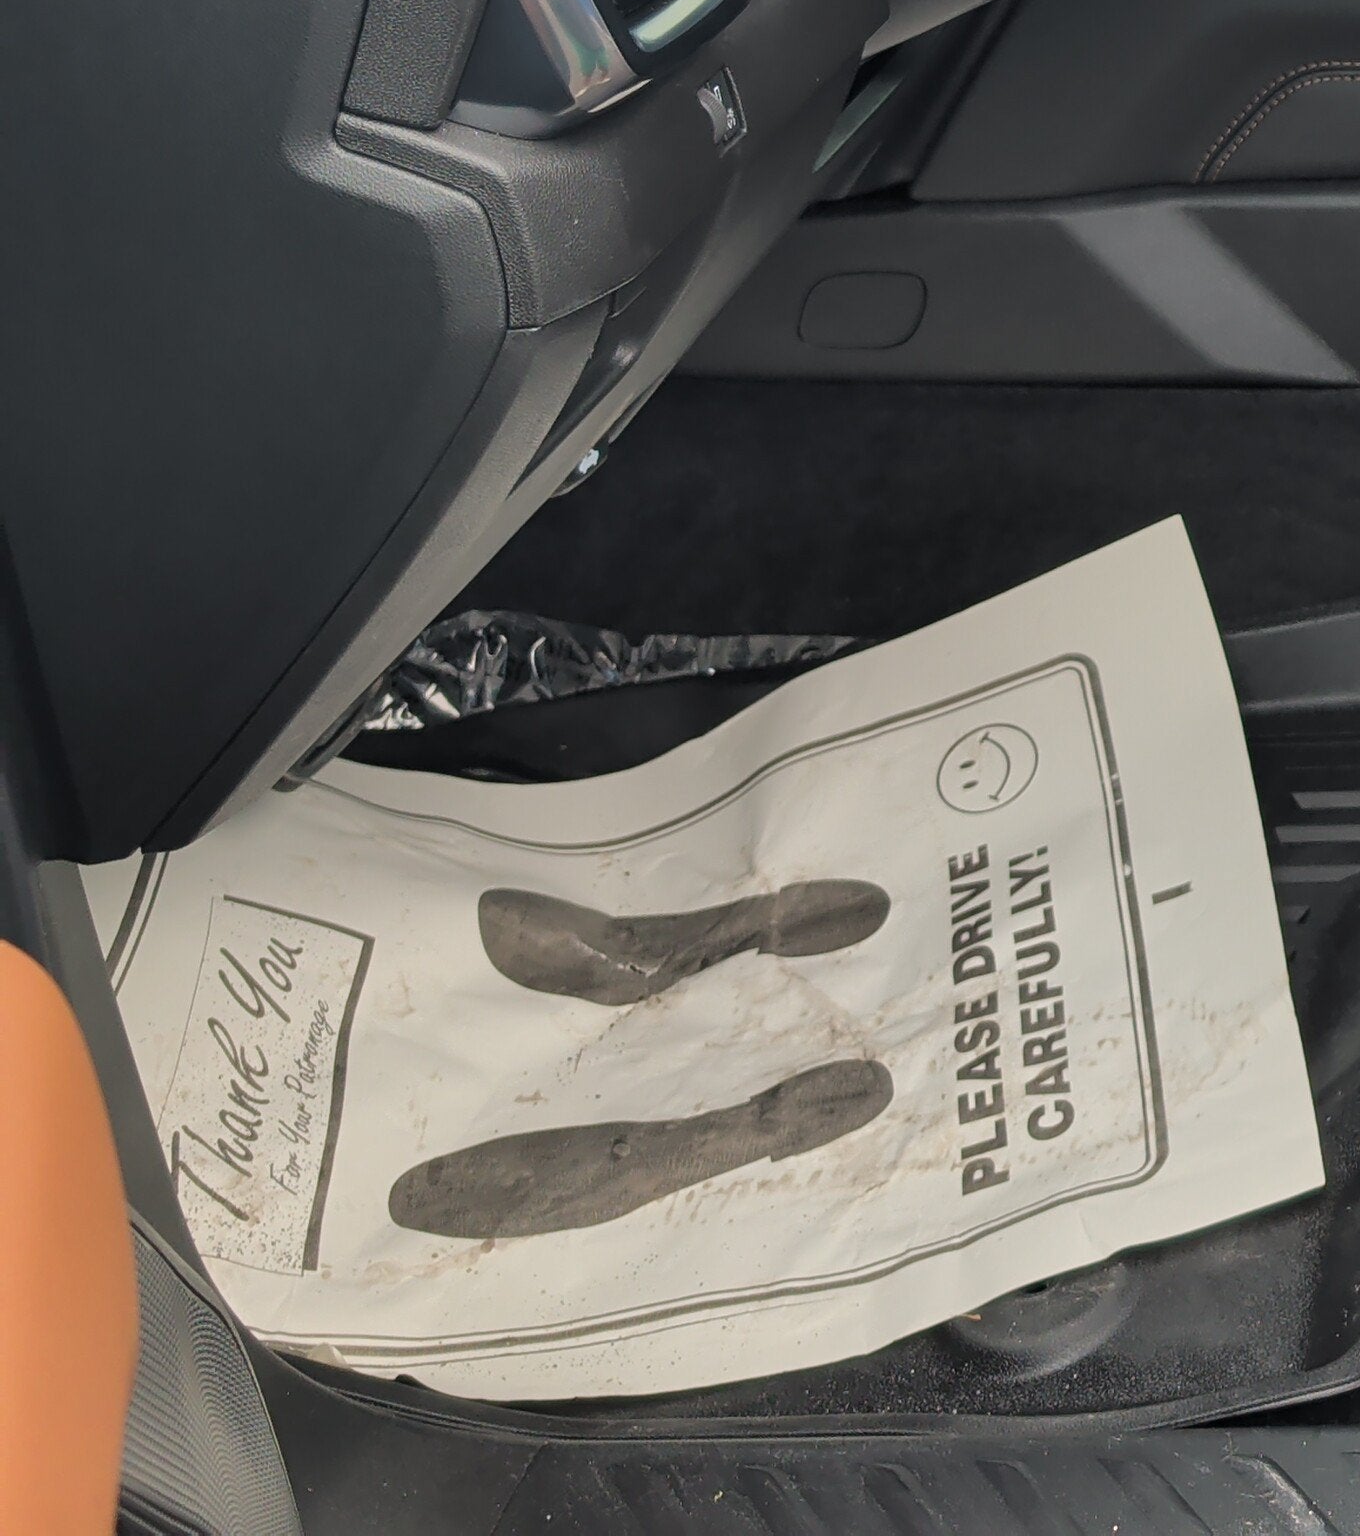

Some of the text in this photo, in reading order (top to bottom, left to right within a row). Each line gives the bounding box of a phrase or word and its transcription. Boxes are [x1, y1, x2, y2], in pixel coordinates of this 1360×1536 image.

[169, 938, 304, 1221] Thank You
[269, 999, 334, 1193] For Your Patronage
[948, 843, 1010, 1196] PLEASE DRIVE
[1008, 845, 1076, 1141] CAREFULLY!
